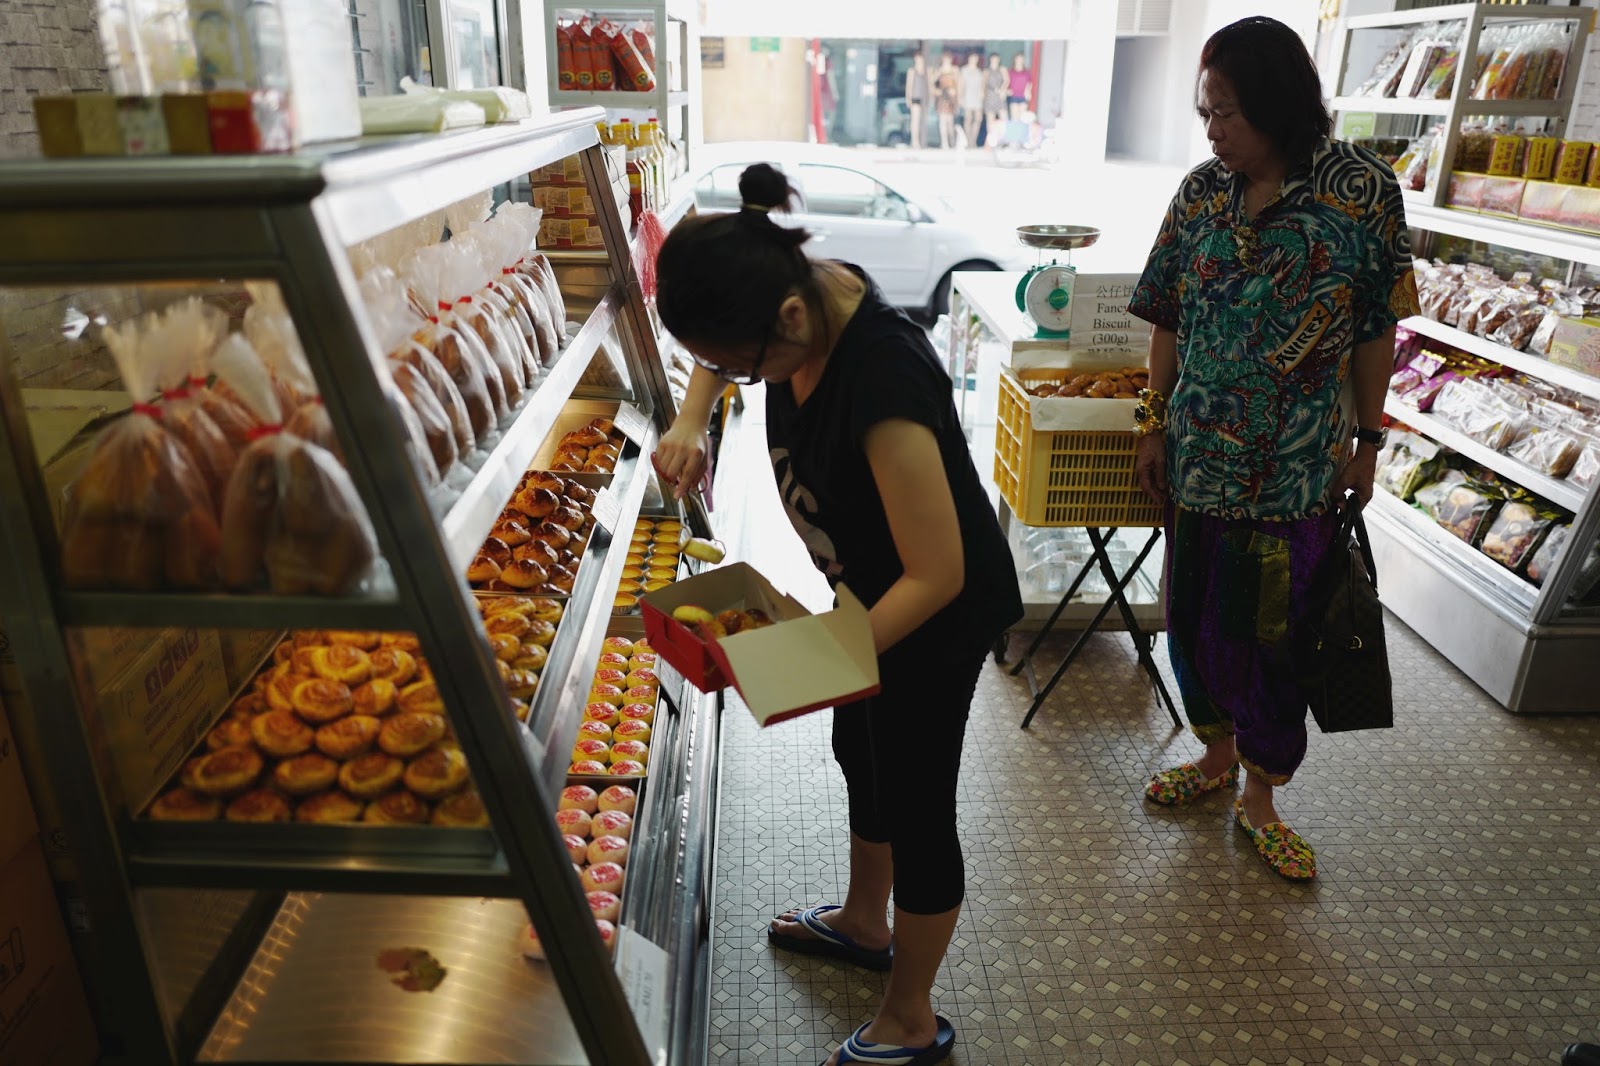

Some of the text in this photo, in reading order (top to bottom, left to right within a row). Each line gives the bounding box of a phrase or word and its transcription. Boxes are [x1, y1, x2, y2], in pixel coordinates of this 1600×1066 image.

[1097, 302, 1128, 316] Fancy
[1093, 318, 1131, 329] Biscuit
[1092, 333, 1129, 346] (300g)
